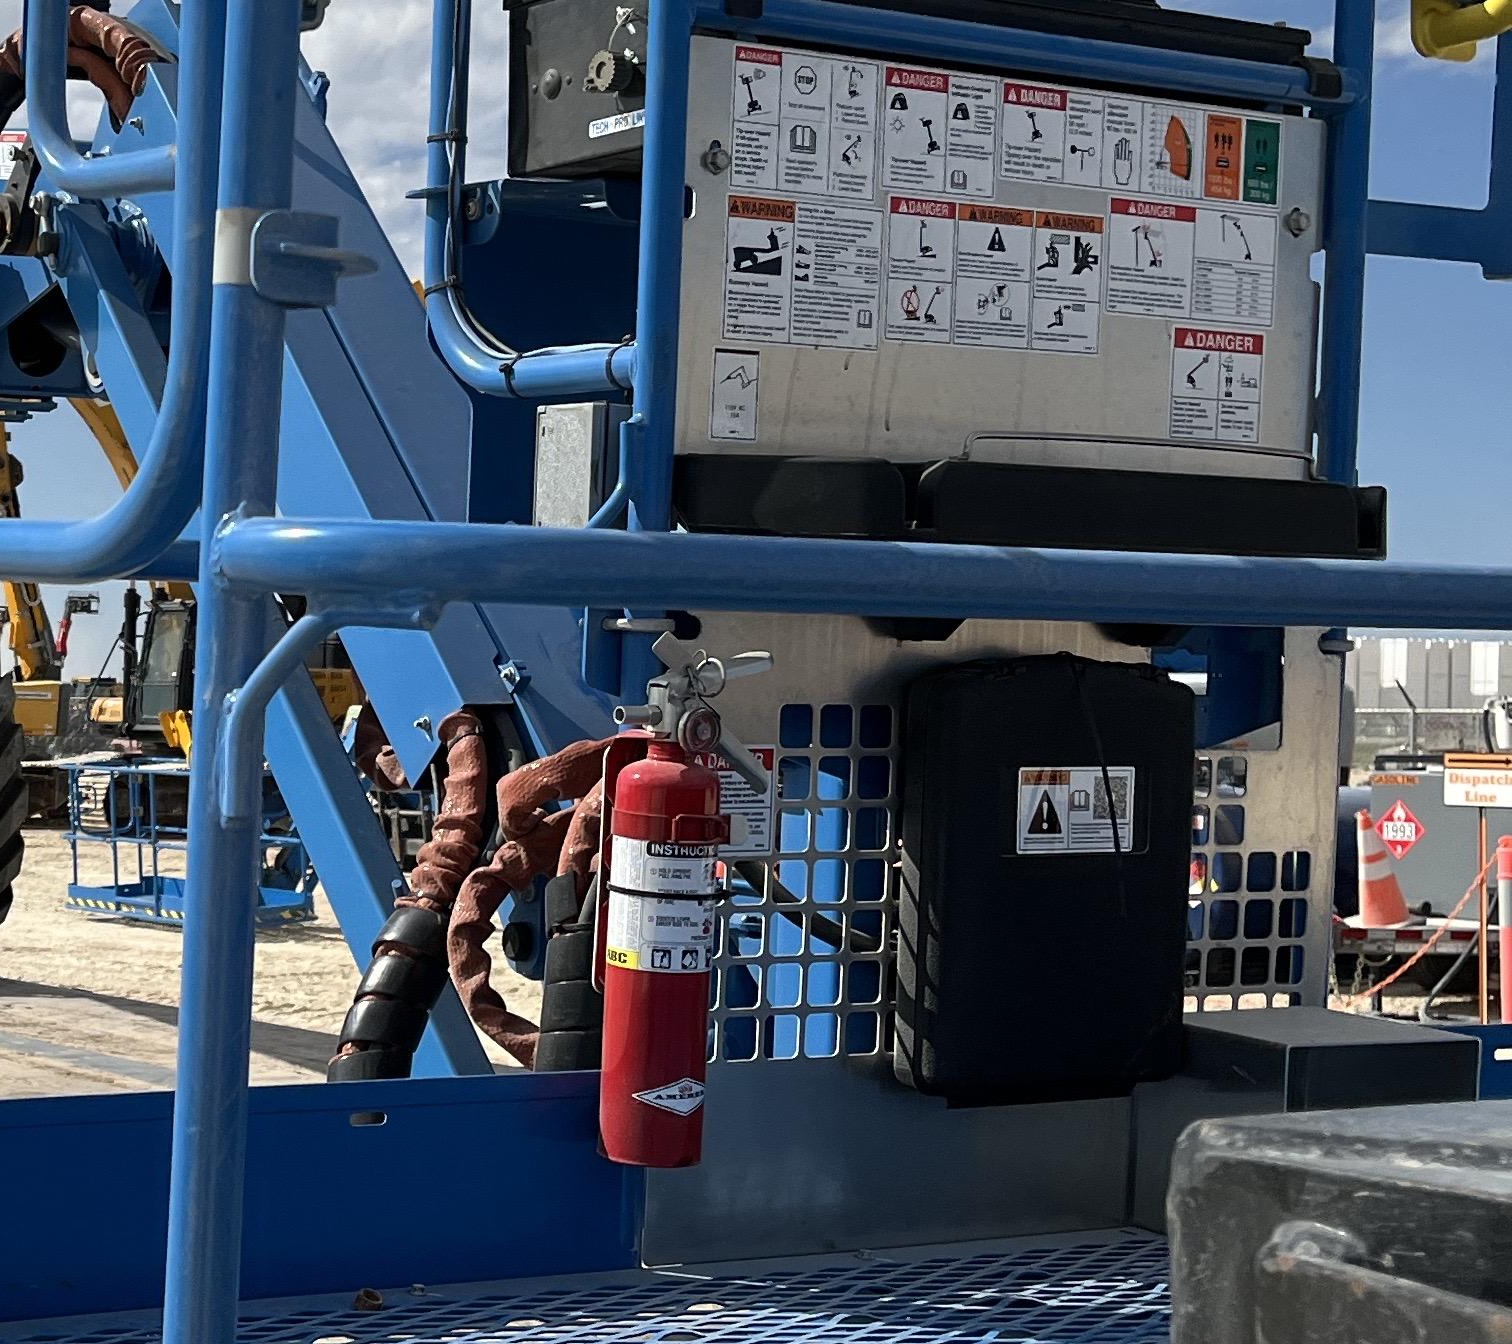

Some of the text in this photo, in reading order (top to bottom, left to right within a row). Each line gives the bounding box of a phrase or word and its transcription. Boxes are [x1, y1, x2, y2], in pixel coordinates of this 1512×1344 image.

[797, 74, 814, 86] STOP
[902, 72, 944, 89] DANGER
[1020, 88, 1061, 107] DANGER
[740, 200, 794, 220] WARNING
[908, 200, 949, 216] DANGER
[1137, 203, 1176, 218] DANGER
[976, 209, 1023, 225] WARNING
[1054, 215, 1095, 232] WARNING
[1196, 332, 1254, 352] DANGER
[1464, 790, 1496, 803] Line
[1385, 824, 1414, 840] 1993
[607, 948, 628, 964] ABC
